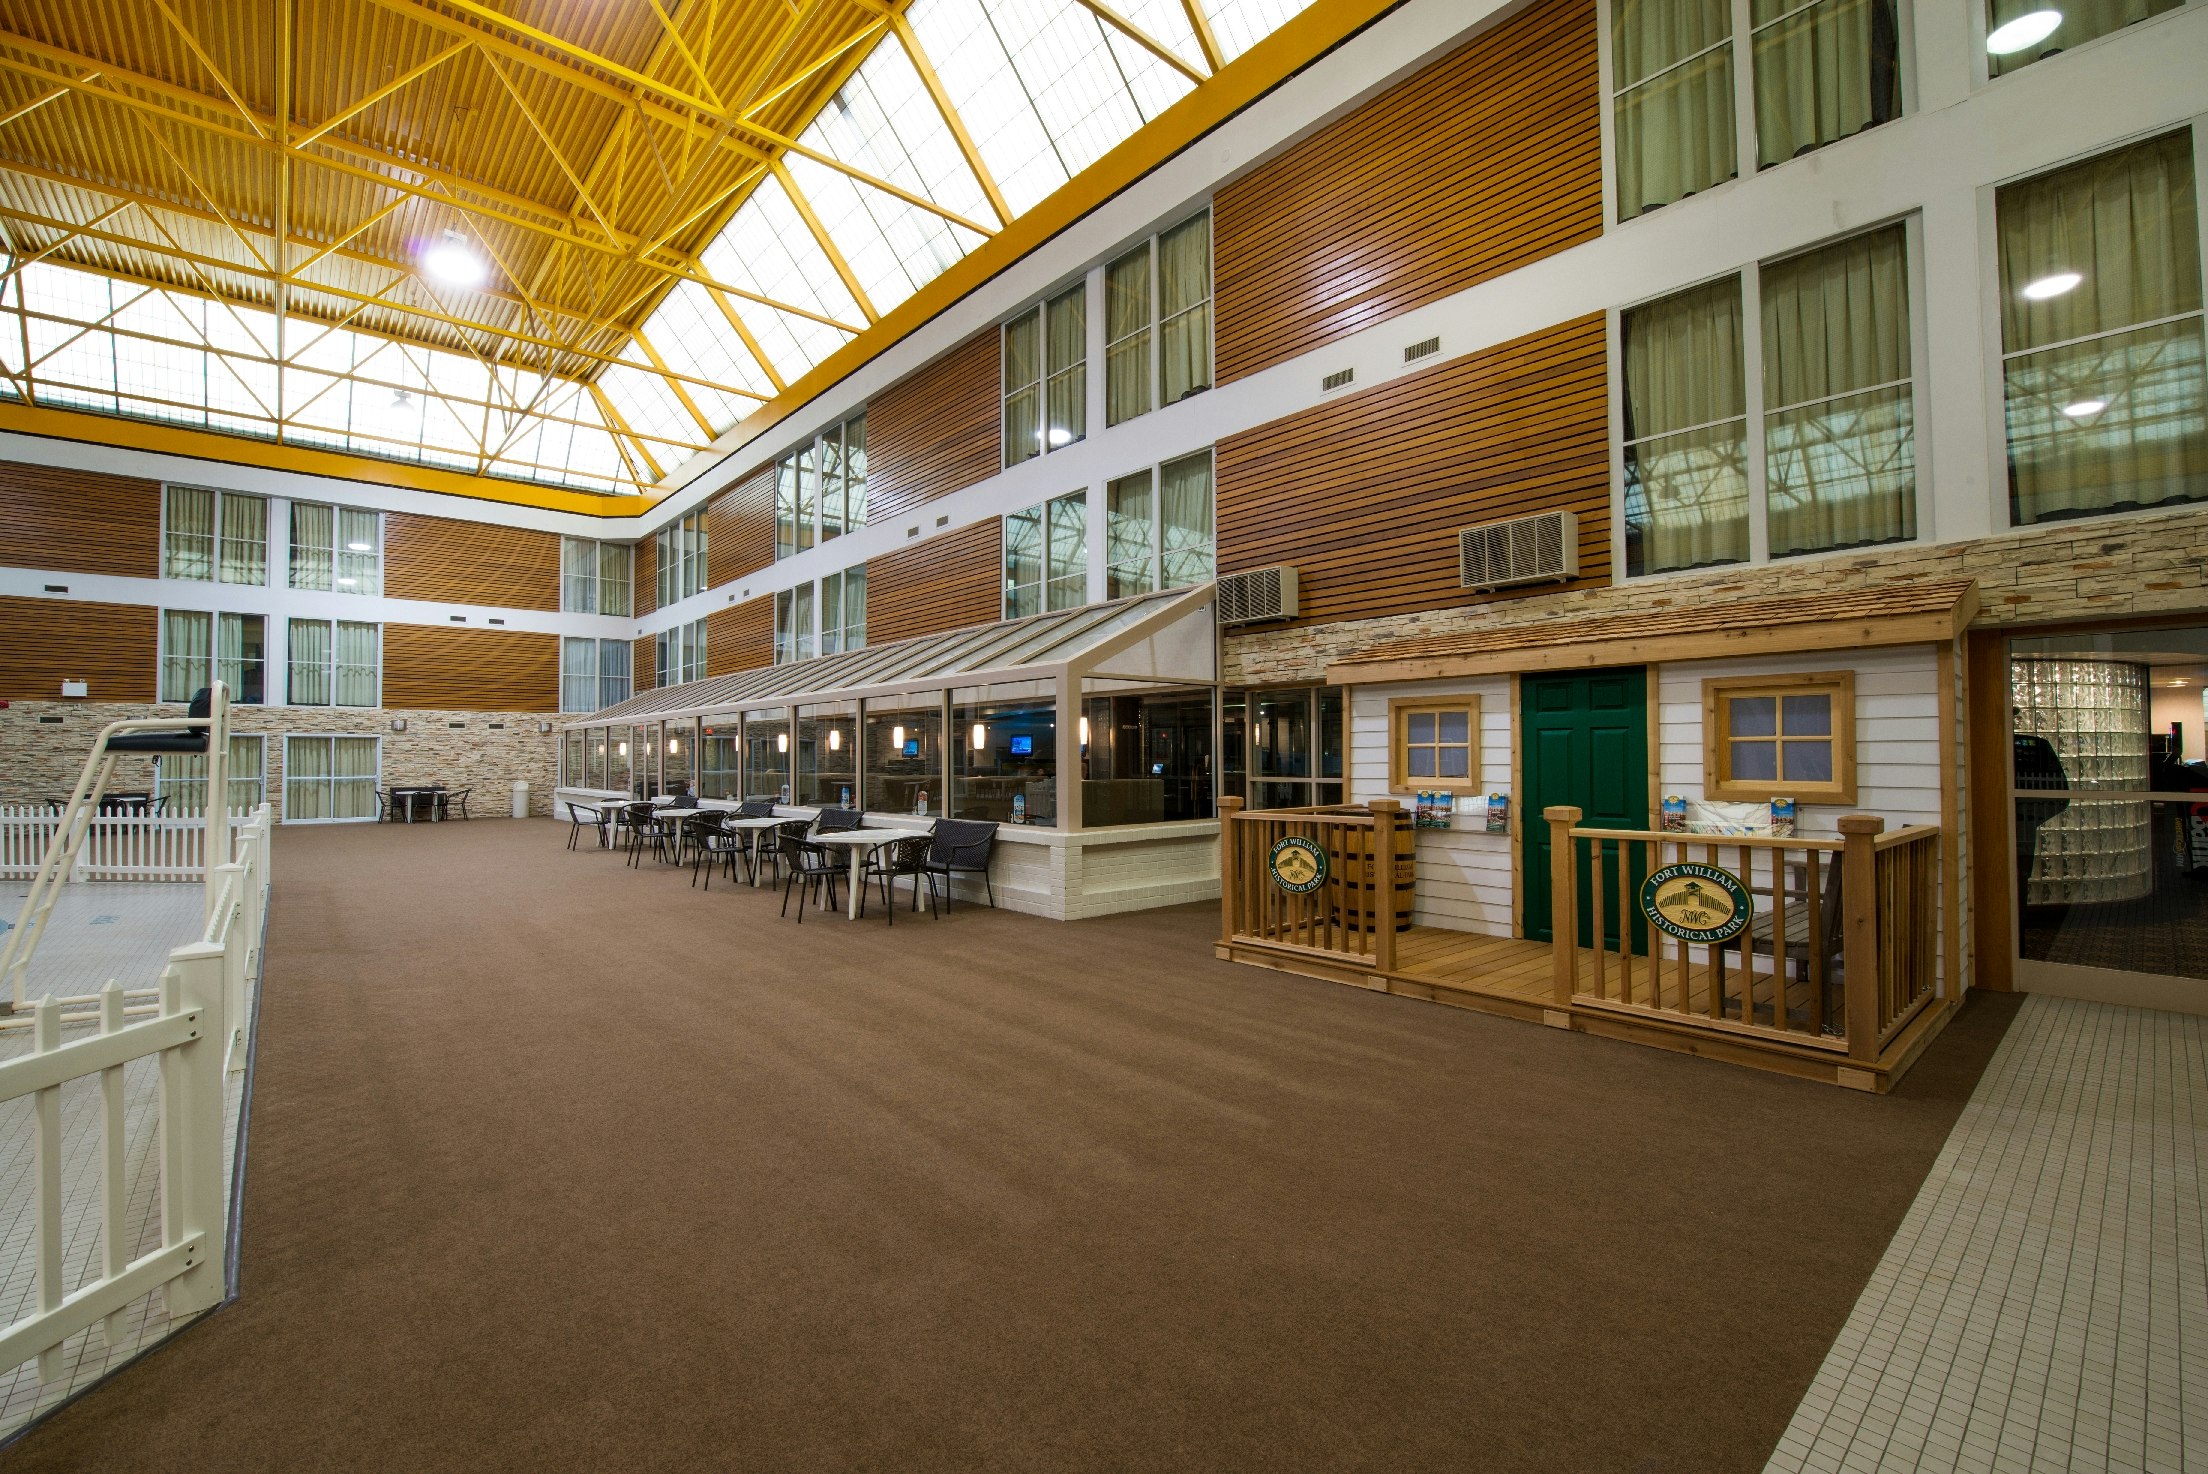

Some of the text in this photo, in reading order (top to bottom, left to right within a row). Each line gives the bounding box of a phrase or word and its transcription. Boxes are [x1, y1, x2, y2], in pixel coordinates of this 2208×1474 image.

[1273, 838, 1320, 857] FORT WILLIAM
[1271, 867, 1307, 892] HISTORICAL
[1307, 872, 1323, 890] PARK
[1650, 865, 1738, 892] FORT WILLIAM
[1646, 905, 1745, 941] HISTORICAL PARK
